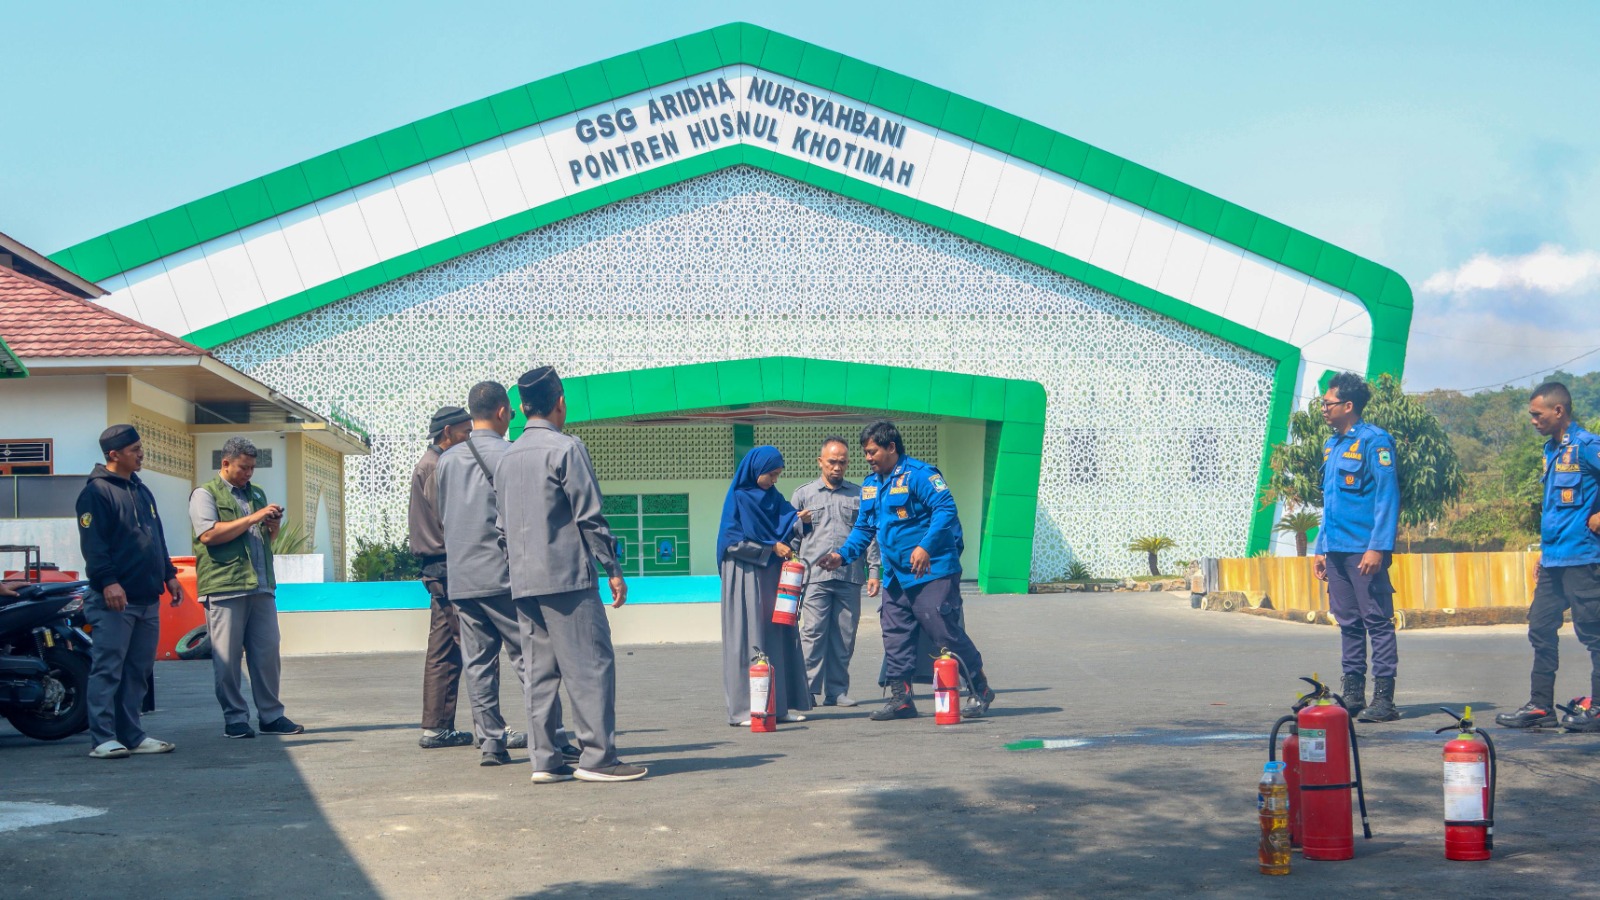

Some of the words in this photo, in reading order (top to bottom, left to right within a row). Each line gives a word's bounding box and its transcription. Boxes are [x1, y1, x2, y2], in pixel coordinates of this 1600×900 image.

[569, 130, 679, 185] PONTREN
[686, 111, 779, 148] HUSNUL
[792, 126, 915, 187] KHOTIMAH
[575, 107, 638, 144] GSG
[648, 77, 736, 125] ARIDHA
[746, 76, 907, 149] NURSYAHBANI
